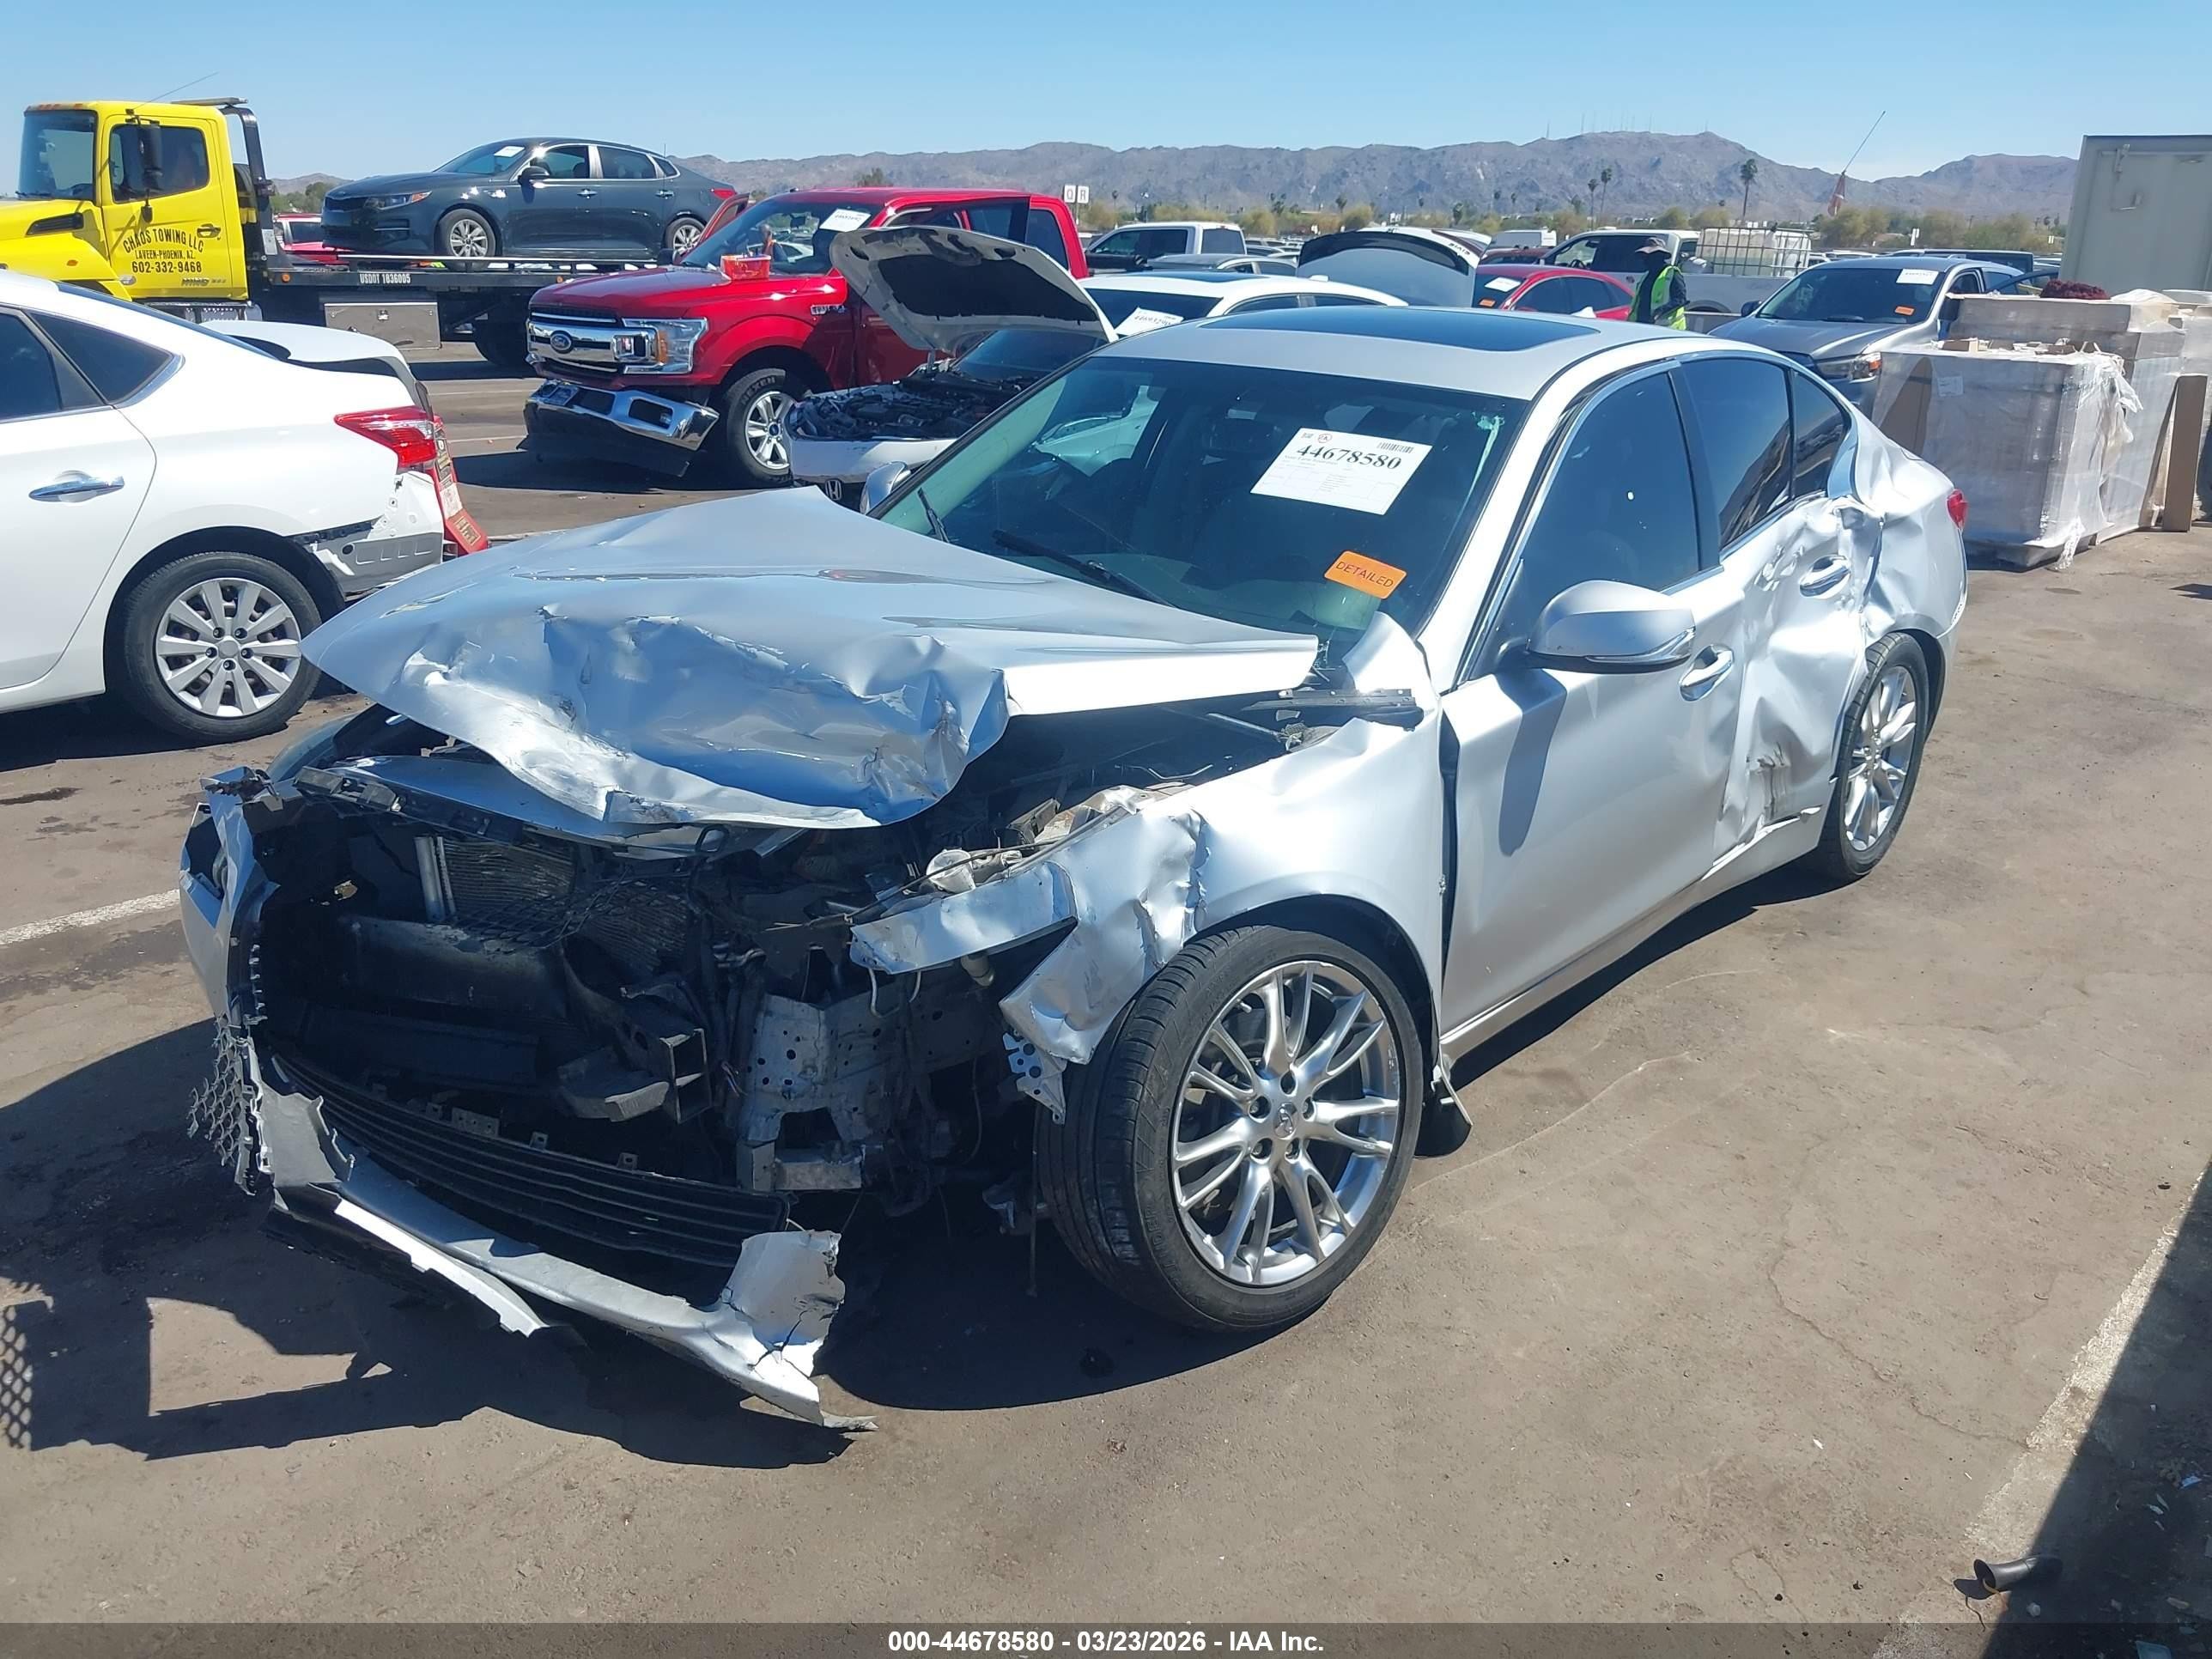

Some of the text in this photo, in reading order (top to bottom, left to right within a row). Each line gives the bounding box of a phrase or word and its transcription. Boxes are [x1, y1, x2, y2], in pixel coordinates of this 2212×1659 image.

[123, 228, 204, 253] CHAOS TOWING LLC
[131, 261, 202, 273] 602-332-9468
[359, 273, 411, 284] USDOT 1836005
[1297, 445, 1401, 470] 44678580
[1335, 561, 1394, 587] DETAILED
